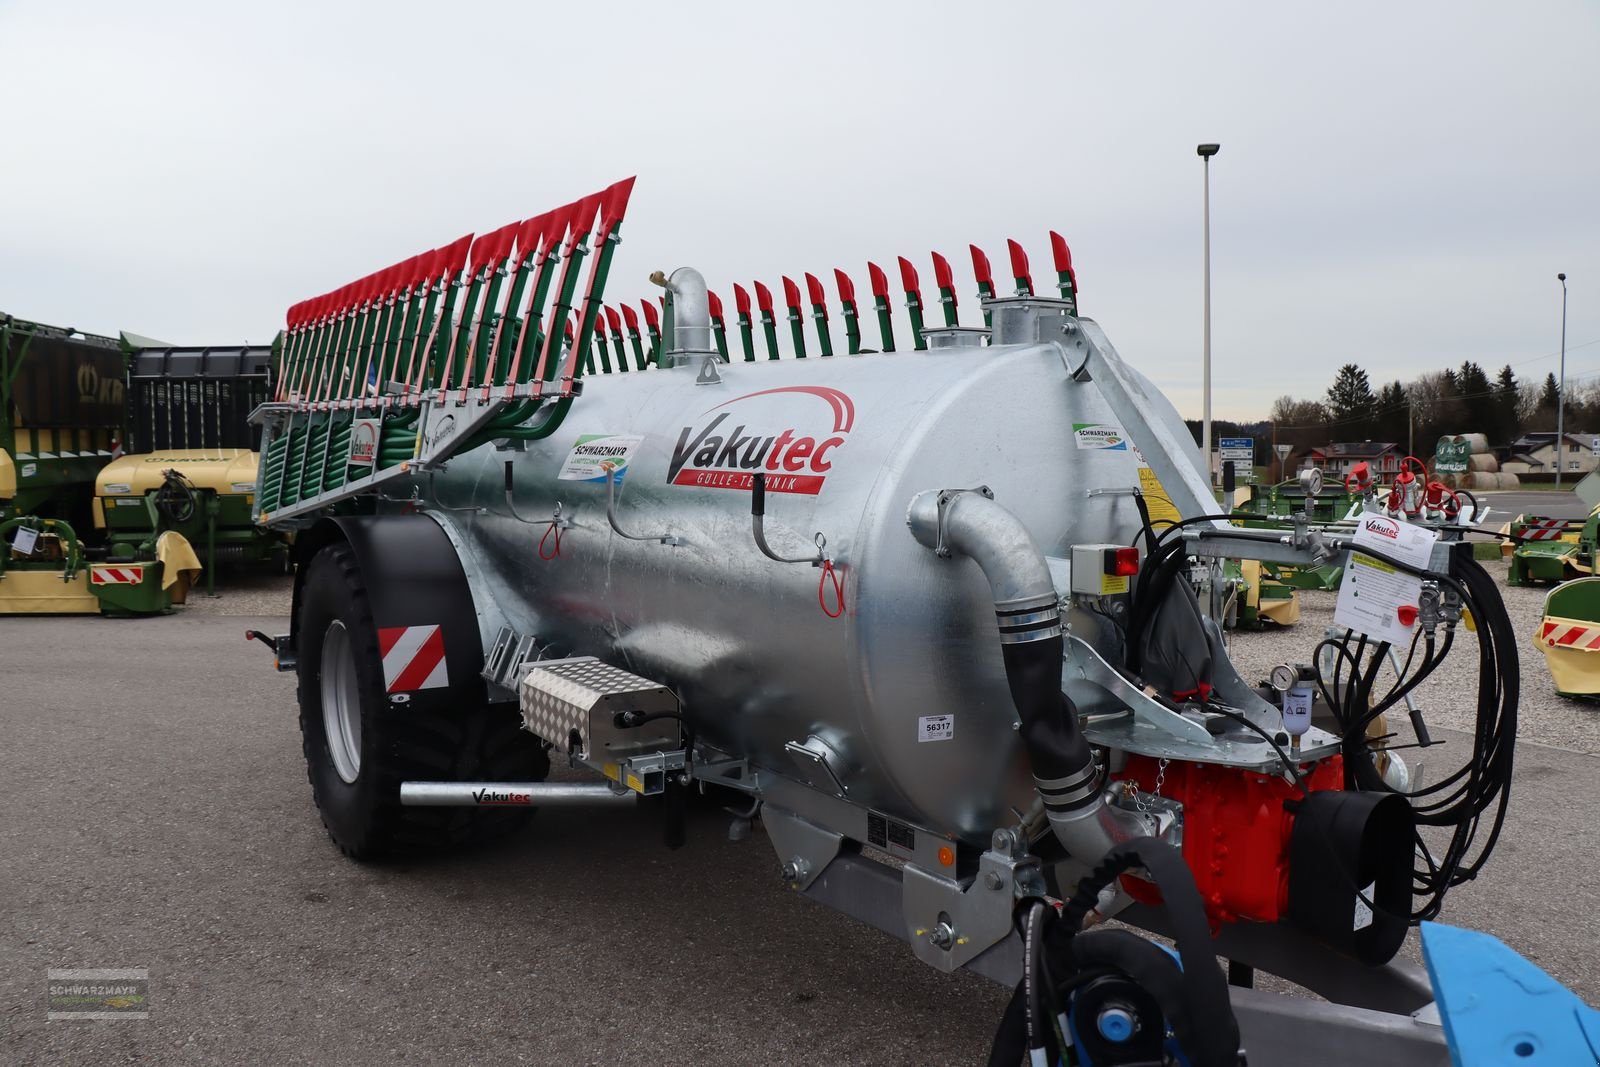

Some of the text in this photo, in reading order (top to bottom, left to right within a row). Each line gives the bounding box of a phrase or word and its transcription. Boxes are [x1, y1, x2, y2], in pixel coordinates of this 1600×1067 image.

[1078, 429, 1118, 437] SCHWARZMAYR
[351, 433, 375, 456] Vakutec
[574, 445, 628, 457] SCHWARZMAYR
[666, 412, 845, 484] Vakutec
[696, 472, 798, 490] GÜLLE-TEHNIK
[1365, 519, 1399, 537] Vakutec
[926, 722, 950, 731] 56317
[472, 787, 530, 804] Vakutec
